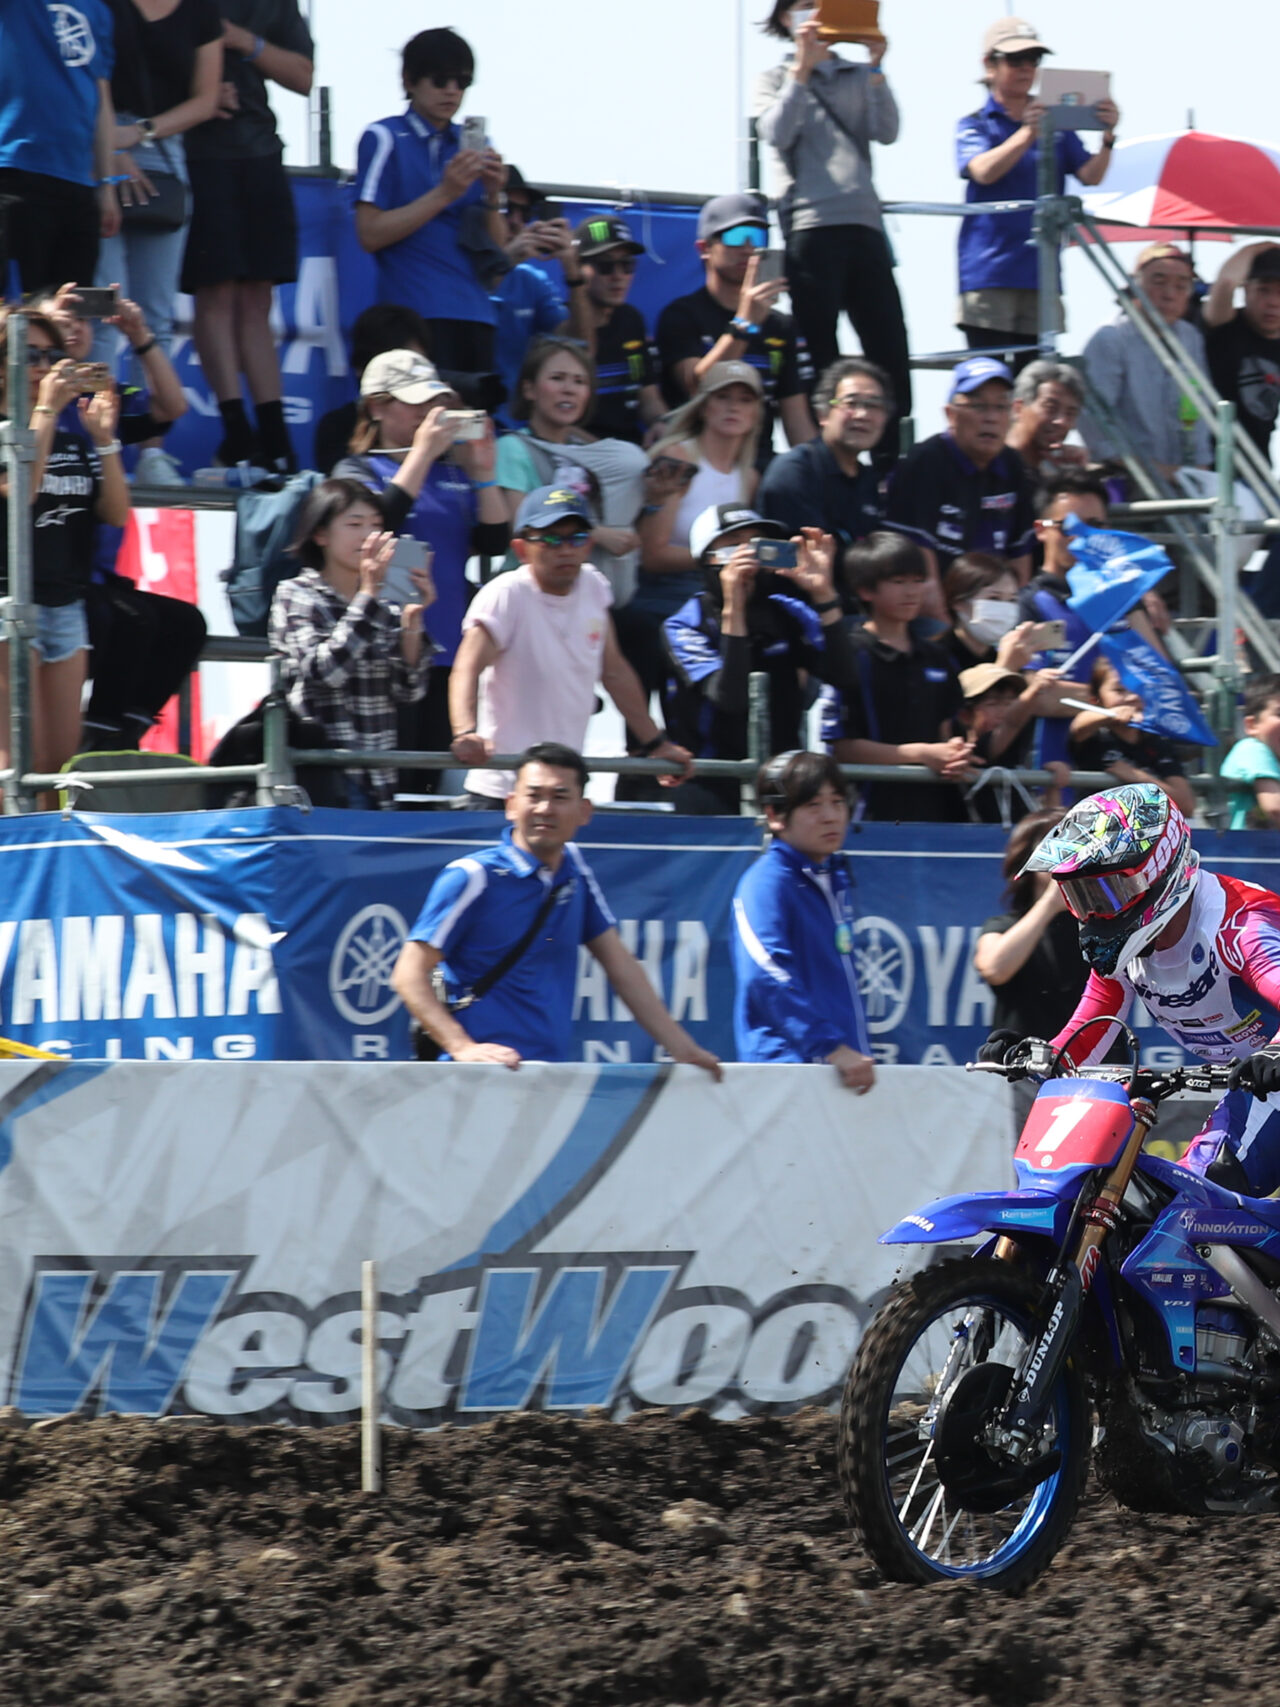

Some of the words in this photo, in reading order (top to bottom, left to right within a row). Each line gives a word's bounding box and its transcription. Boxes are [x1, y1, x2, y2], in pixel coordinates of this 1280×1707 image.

[1233, 1021, 1264, 1042] MOTUL
[1034, 1101, 1094, 1152] 1
[1193, 1221, 1270, 1235] INNOVATION
[14, 1257, 866, 1421] WestWoo
[1026, 1301, 1064, 1388] DUNLOP
